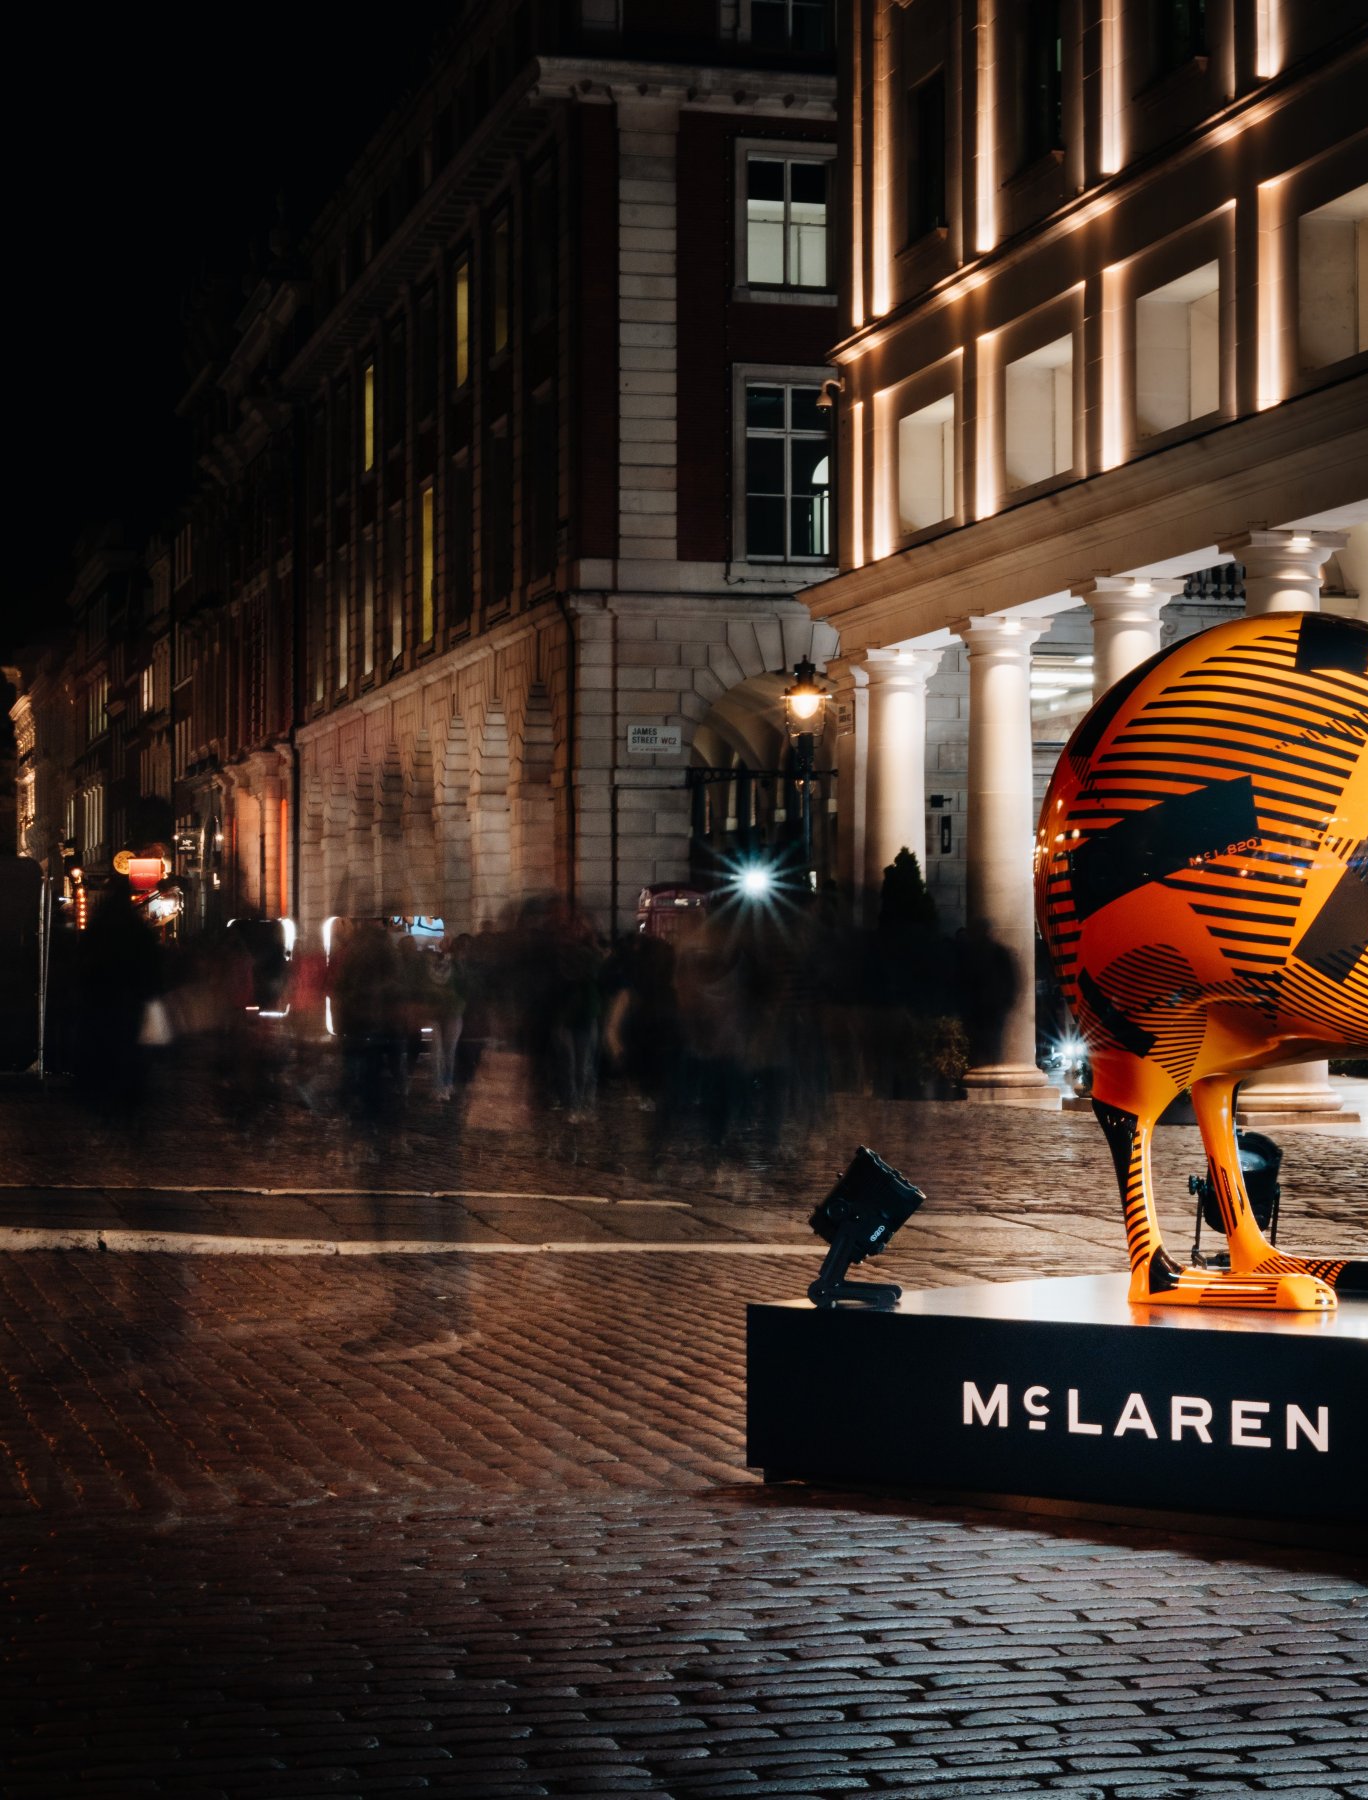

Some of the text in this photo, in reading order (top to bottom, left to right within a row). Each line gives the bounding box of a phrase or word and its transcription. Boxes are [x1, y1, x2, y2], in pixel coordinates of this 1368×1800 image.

[632, 727, 658, 736] JAMES
[632, 736, 659, 744] STREET
[963, 1381, 1329, 1452] McLAREN
